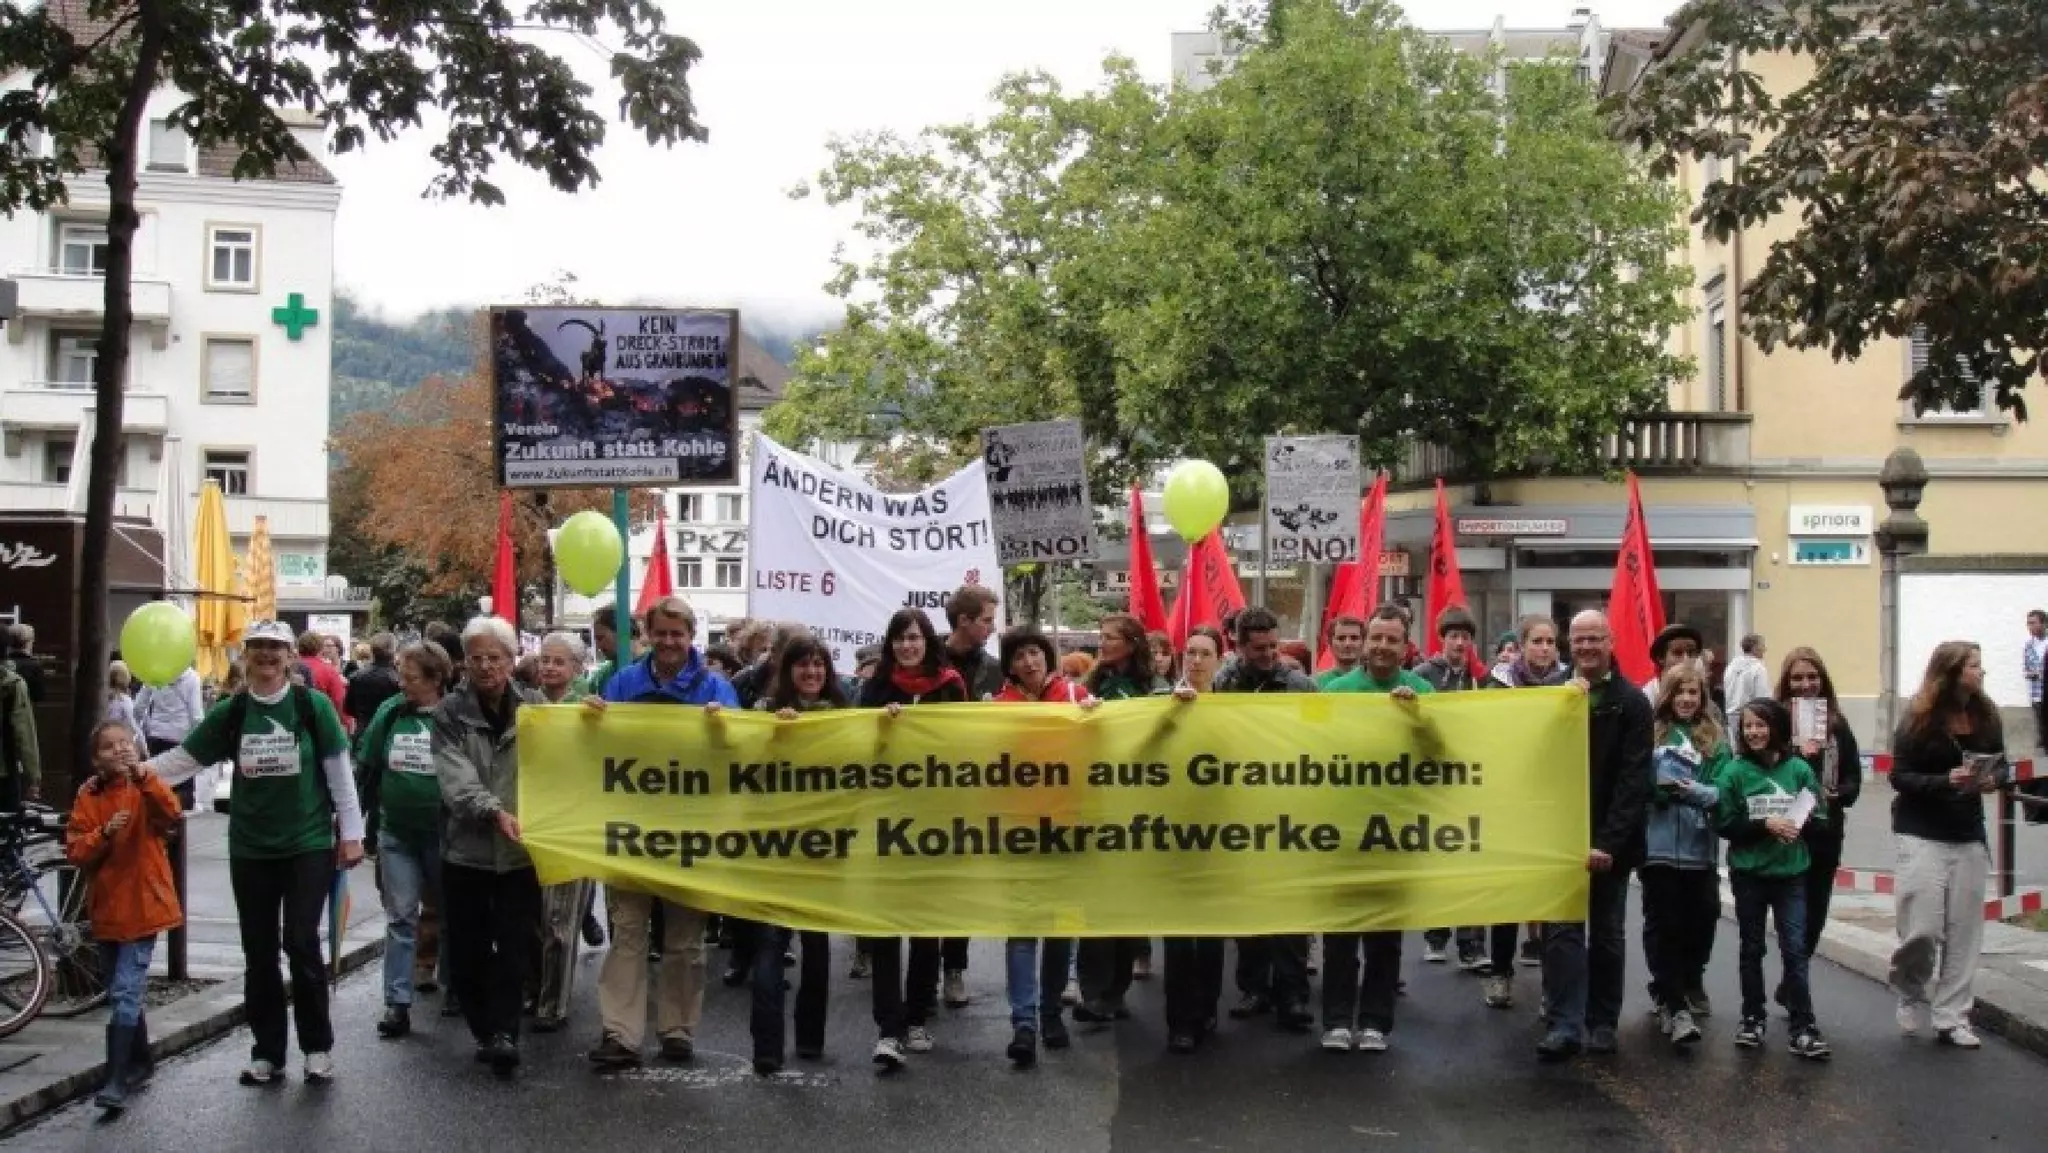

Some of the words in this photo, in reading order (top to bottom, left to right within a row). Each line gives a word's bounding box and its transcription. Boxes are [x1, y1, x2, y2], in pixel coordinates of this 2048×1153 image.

[640, 315, 677, 335] KEIN
[615, 352, 643, 369] AUS
[505, 423, 559, 436] Verein
[505, 440, 597, 459] Zukunft
[602, 440, 657, 457] statt
[661, 438, 727, 457] Kohle
[763, 455, 874, 513] ÄNDERN
[883, 489, 949, 517] WAS
[812, 515, 876, 548] DICH
[889, 519, 988, 551] STÖRT!
[1032, 535, 1089, 557] NO!
[1301, 535, 1356, 561] NO!
[756, 570, 813, 593] LISTE
[820, 569, 836, 596] 6
[603, 757, 710, 795] Kein
[729, 753, 1070, 793] Klimaschaden
[1087, 759, 1170, 787] aus
[1186, 753, 1483, 787] Graubünden:
[605, 821, 859, 868] Repower
[876, 814, 1341, 857] Kohlekraftwerke
[1358, 814, 1482, 853] Ade!
